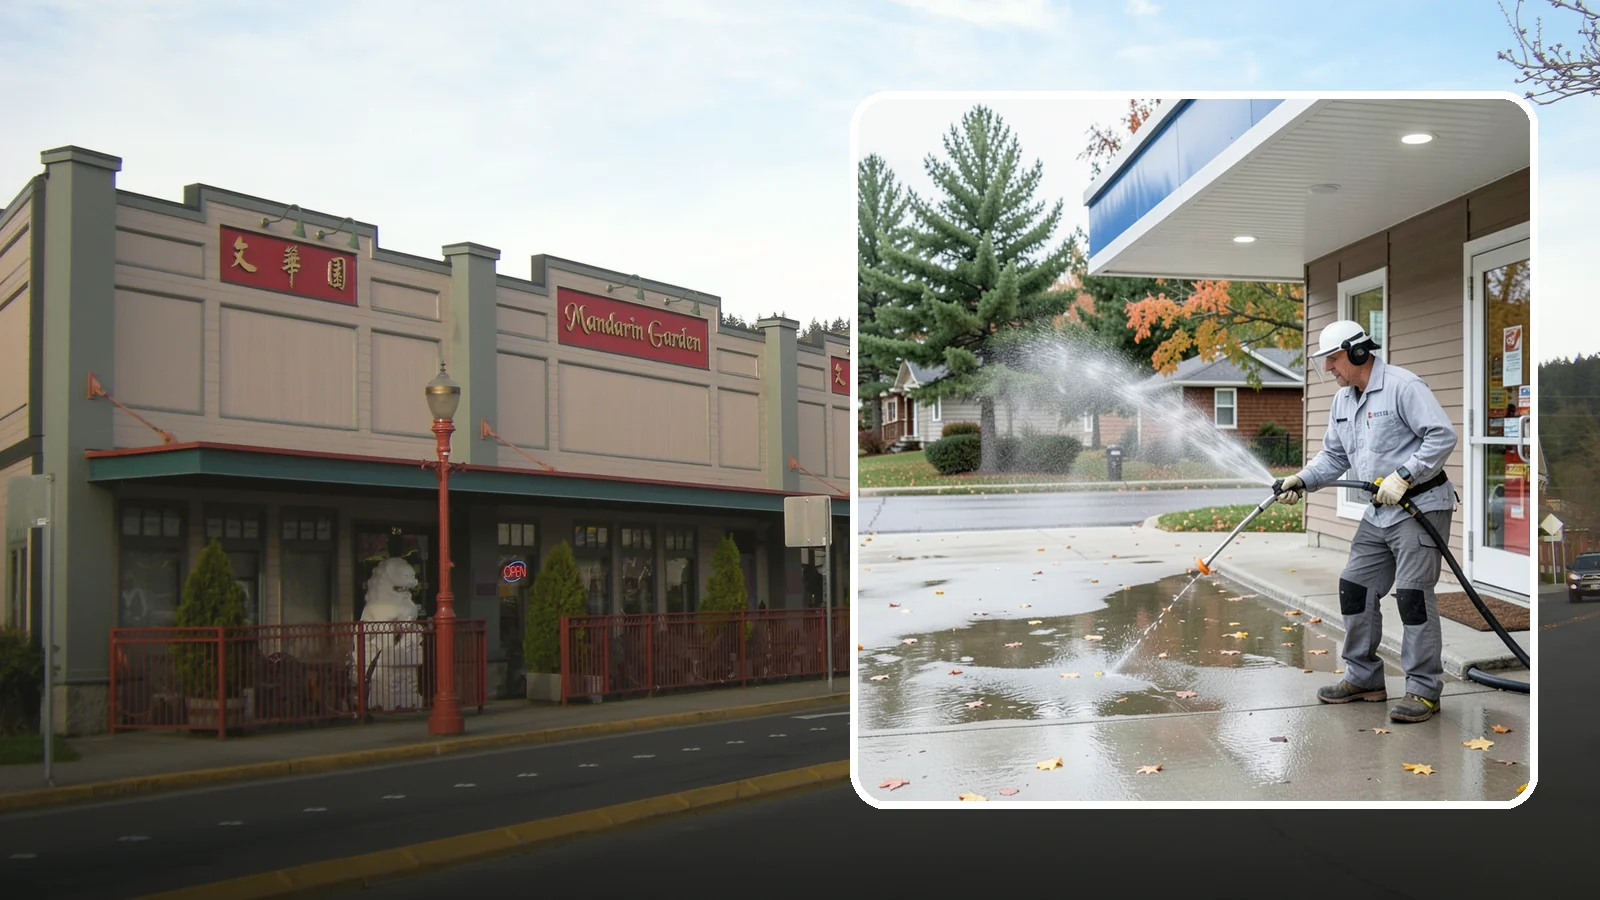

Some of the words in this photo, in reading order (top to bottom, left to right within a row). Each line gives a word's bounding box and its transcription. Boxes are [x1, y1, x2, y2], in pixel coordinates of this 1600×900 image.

[231, 236, 346, 290] 文華園
[565, 302, 644, 341] Mandarin
[648, 320, 702, 352] Garden
[503, 565, 527, 578] OPEN
